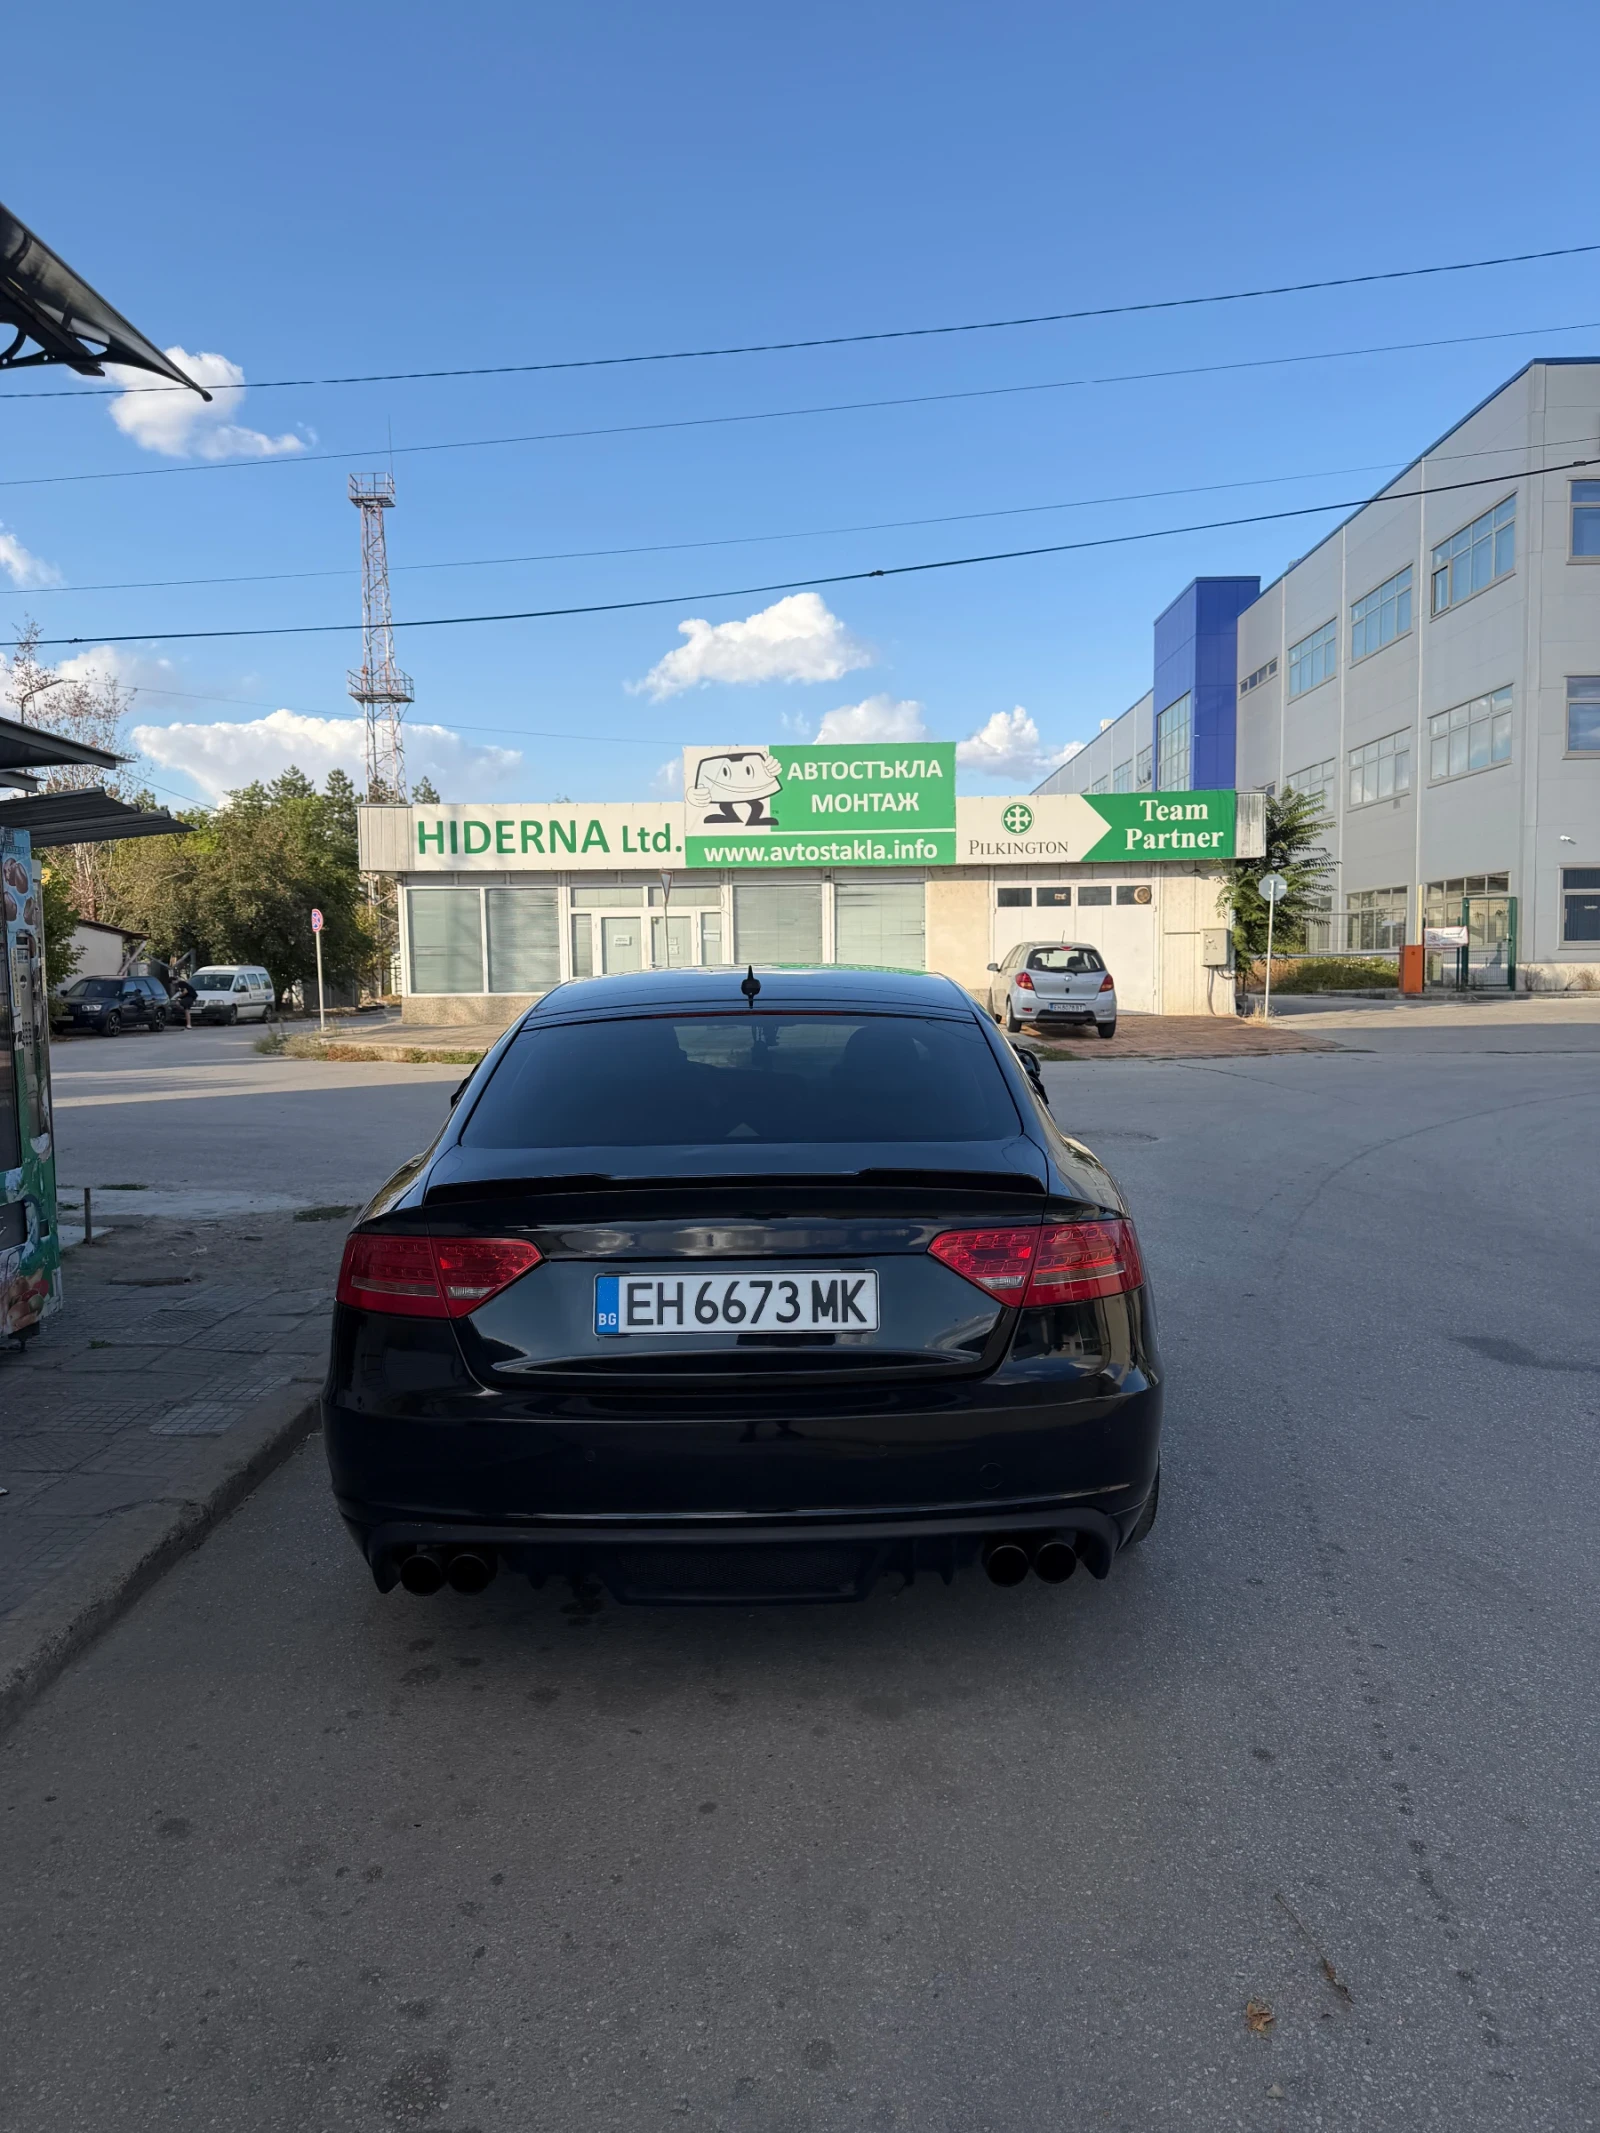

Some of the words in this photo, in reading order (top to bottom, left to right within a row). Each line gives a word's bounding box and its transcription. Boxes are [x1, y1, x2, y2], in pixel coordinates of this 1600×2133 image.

[787, 759, 943, 781] АВТОСТЪКЛА
[811, 792, 919, 813] МОНТАЖ
[1140, 799, 1209, 822] Team
[418, 820, 610, 854] HIDERNA
[622, 823, 682, 853] Ltd.
[968, 840, 1068, 856] PILKINGTON
[1124, 828, 1224, 851] Partner
[704, 839, 938, 862] www.avtostakla.info
[598, 1312, 617, 1326] BG
